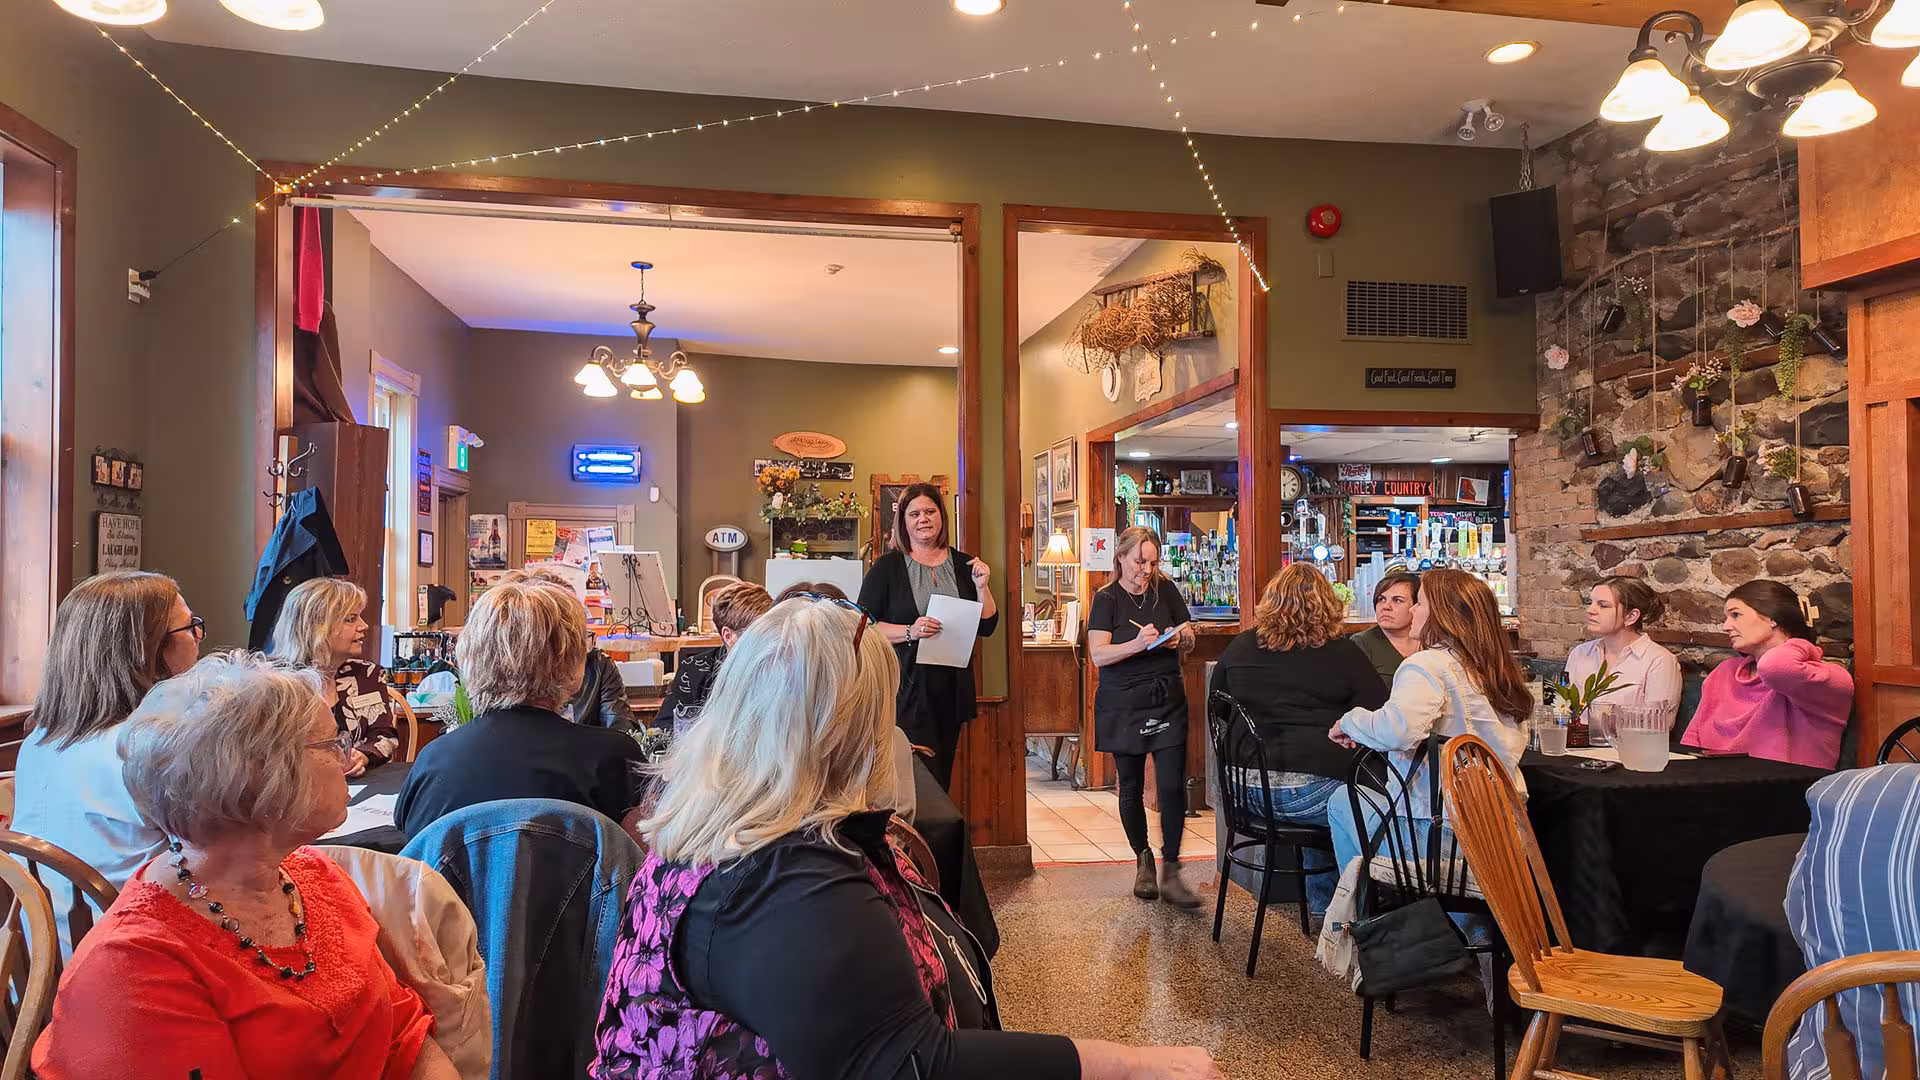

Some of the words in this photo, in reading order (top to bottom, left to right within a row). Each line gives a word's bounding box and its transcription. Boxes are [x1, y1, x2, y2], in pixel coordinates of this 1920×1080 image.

[1370, 370, 1383, 384] Good
[1441, 370, 1453, 384] Times
[1341, 481, 1377, 495] HARLEY
[1384, 481, 1427, 495] COUNTRY
[102, 517, 121, 529] HAVE
[122, 518, 140, 530] HOPE
[116, 529, 136, 543] Strong
[712, 532, 738, 544] ATM
[103, 544, 123, 556] LAUGH
[124, 544, 139, 556] LOUD
